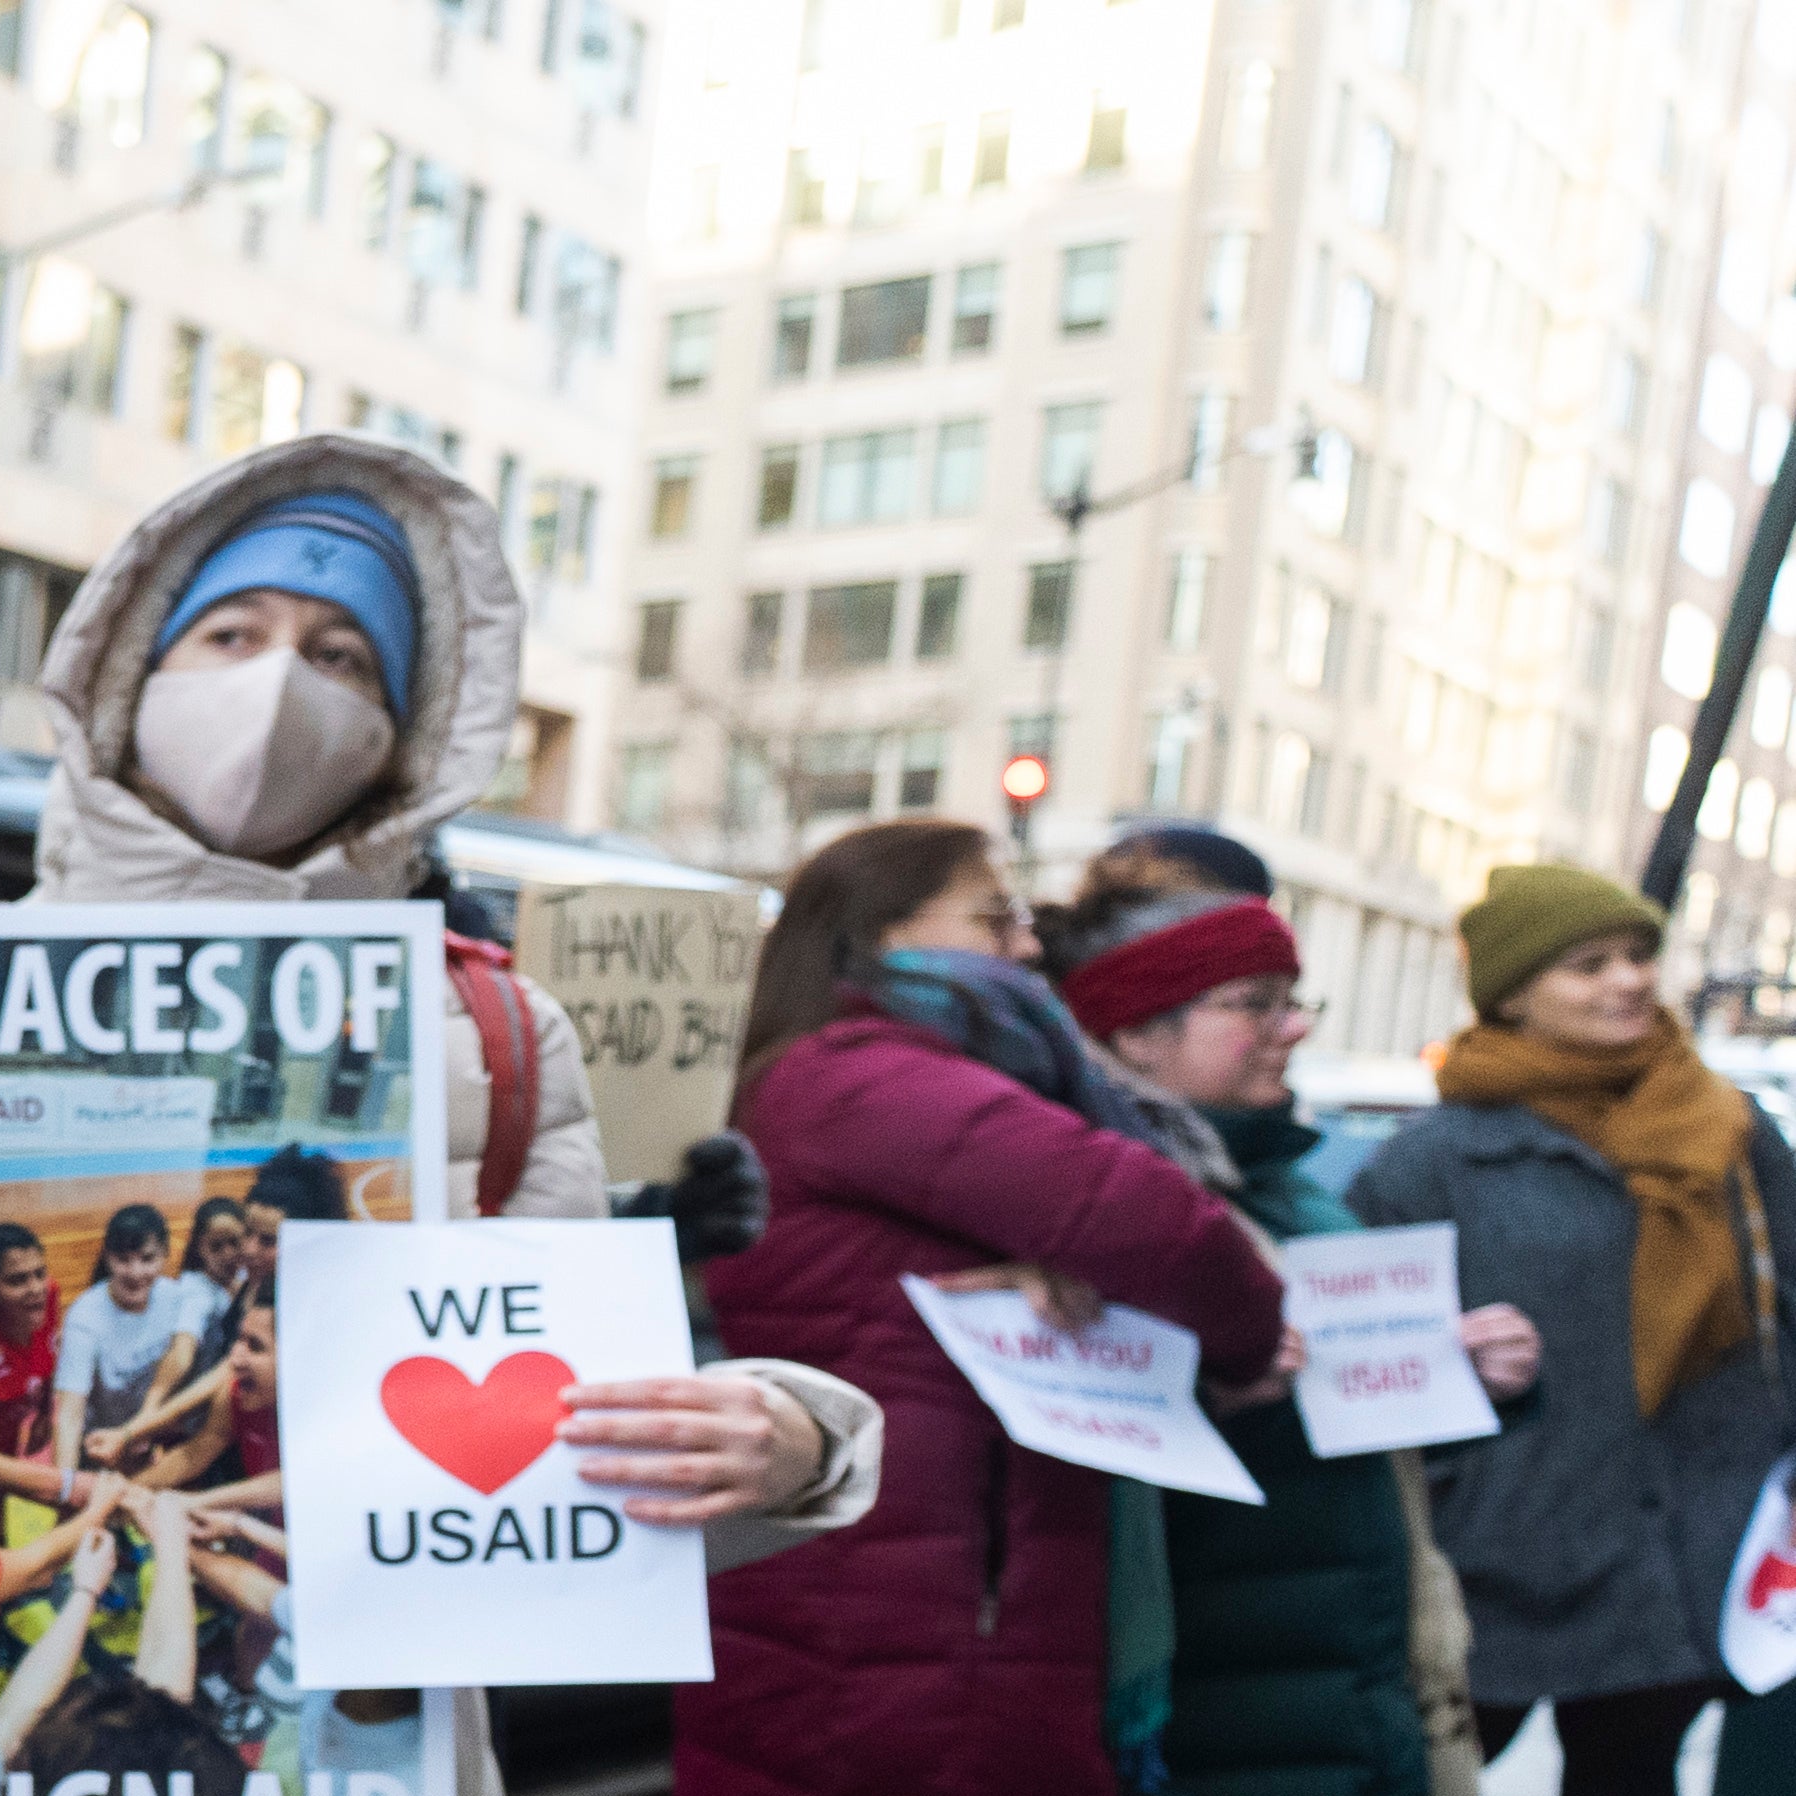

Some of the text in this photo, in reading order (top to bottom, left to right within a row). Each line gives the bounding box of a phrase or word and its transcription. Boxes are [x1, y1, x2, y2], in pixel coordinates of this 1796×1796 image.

[538, 886, 754, 983] THANK YO
[270, 942, 401, 1056] OF
[565, 998, 664, 1067] SAID
[408, 1284, 545, 1339] WE
[366, 1503, 625, 1567] USAID
